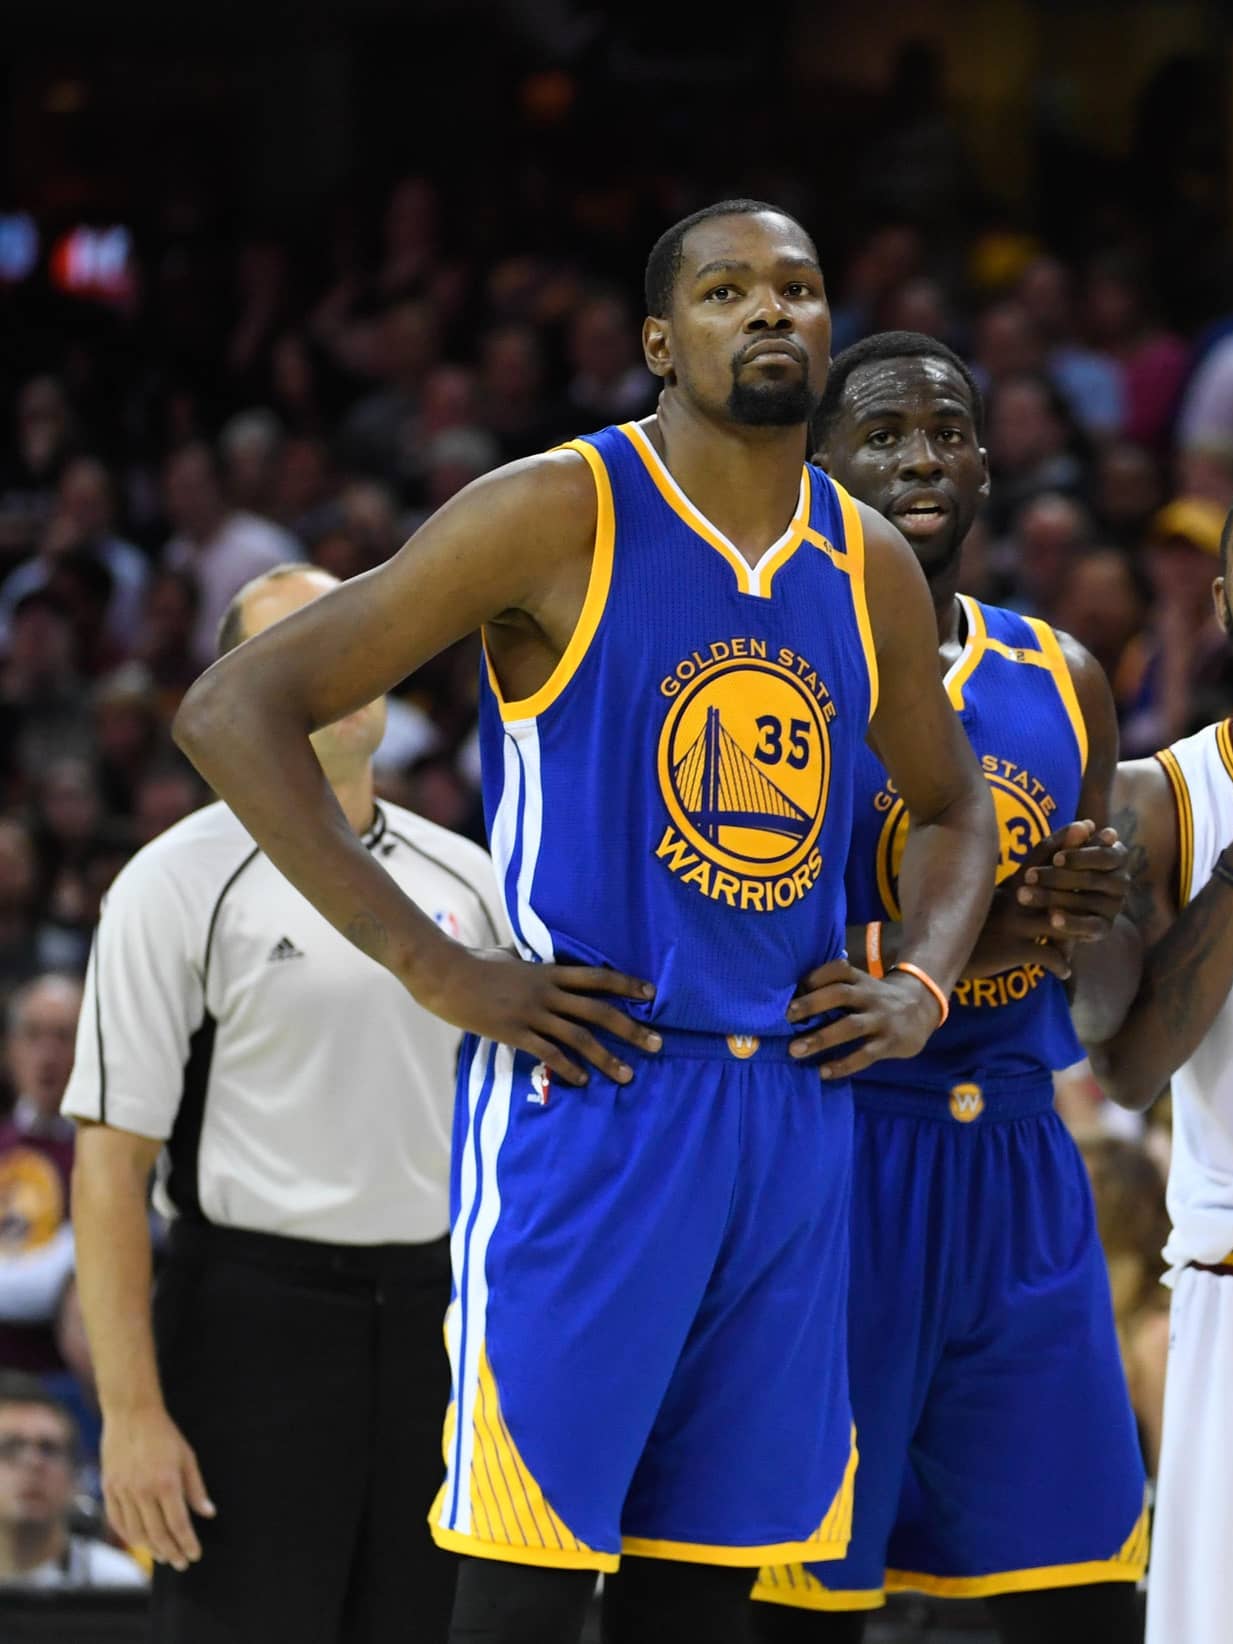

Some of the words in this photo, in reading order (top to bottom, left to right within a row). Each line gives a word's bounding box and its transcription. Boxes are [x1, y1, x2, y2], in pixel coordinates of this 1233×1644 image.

[659, 637, 768, 698] GOLDEN
[777, 648, 838, 723] STATE
[753, 714, 812, 770] 35
[981, 754, 1057, 817] STATE
[655, 825, 823, 912] WARRIORS
[956, 1092, 980, 1113] W
